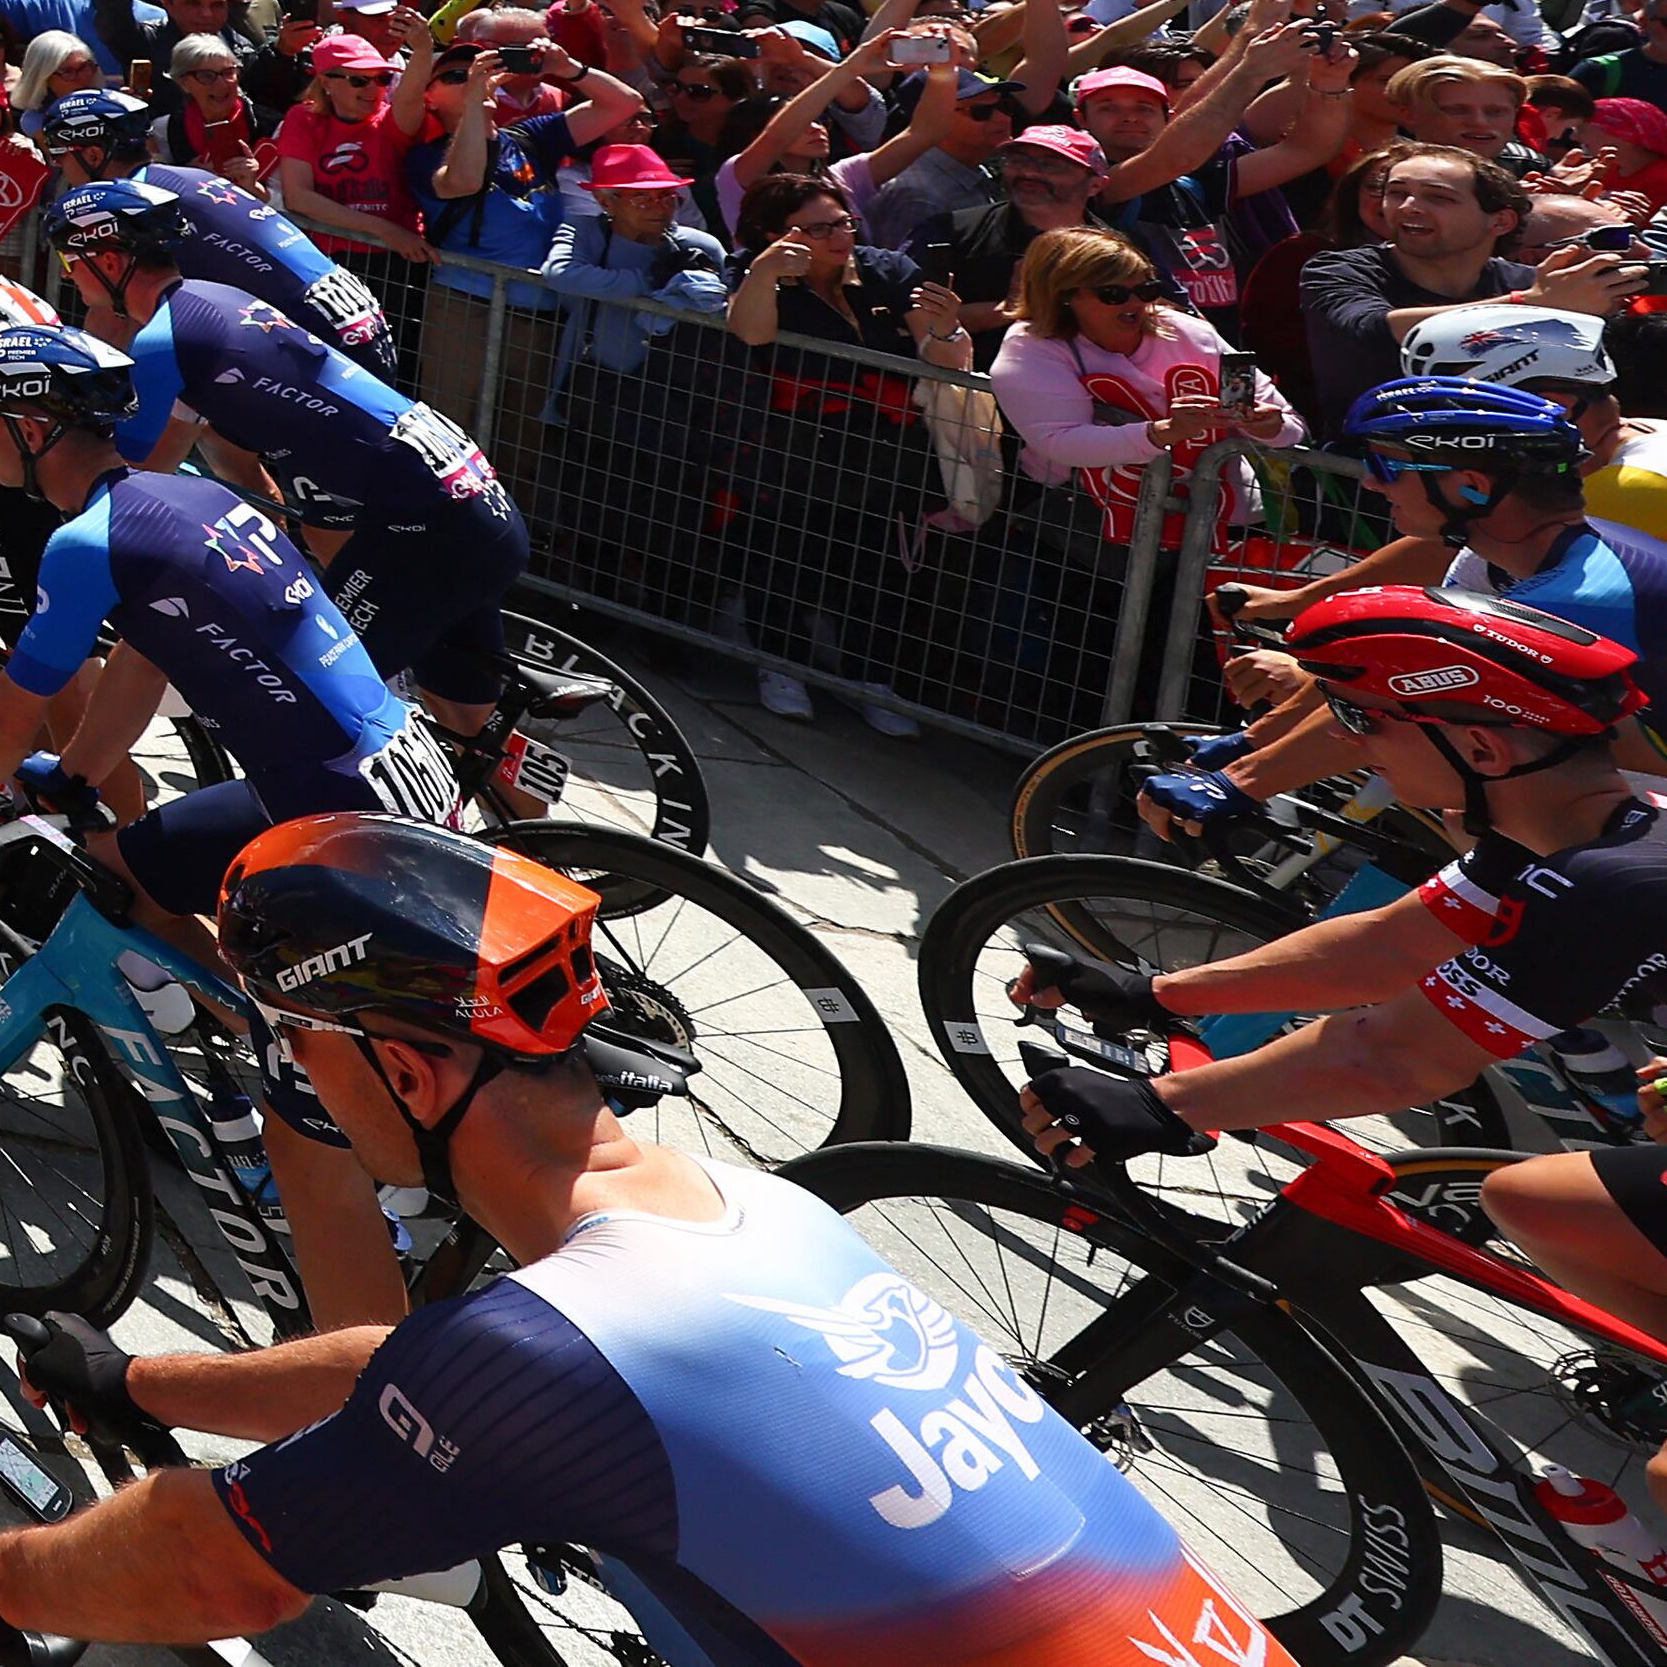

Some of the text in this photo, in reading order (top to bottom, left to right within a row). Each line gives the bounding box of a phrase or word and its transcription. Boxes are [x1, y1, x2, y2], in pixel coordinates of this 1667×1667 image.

[59, 99, 85, 110] ISRAEL
[62, 195, 93, 210] ISRAEL
[203, 232, 274, 274] FACTOR
[7, 349, 38, 357] PREMIER
[252, 375, 340, 418] FACTOR
[196, 621, 298, 704] FACTOR
[1487, 626, 1541, 660] TUDOR
[1403, 669, 1464, 694] ABUS
[524, 635, 686, 778] BLACK
[519, 752, 569, 802] 105
[276, 931, 374, 994] GIANT
[453, 1005, 504, 1021] ALULA
[618, 1069, 673, 1094] italia
[97, 1023, 299, 1312] FACTOR
[1319, 1492, 1410, 1655] DT SWISS
